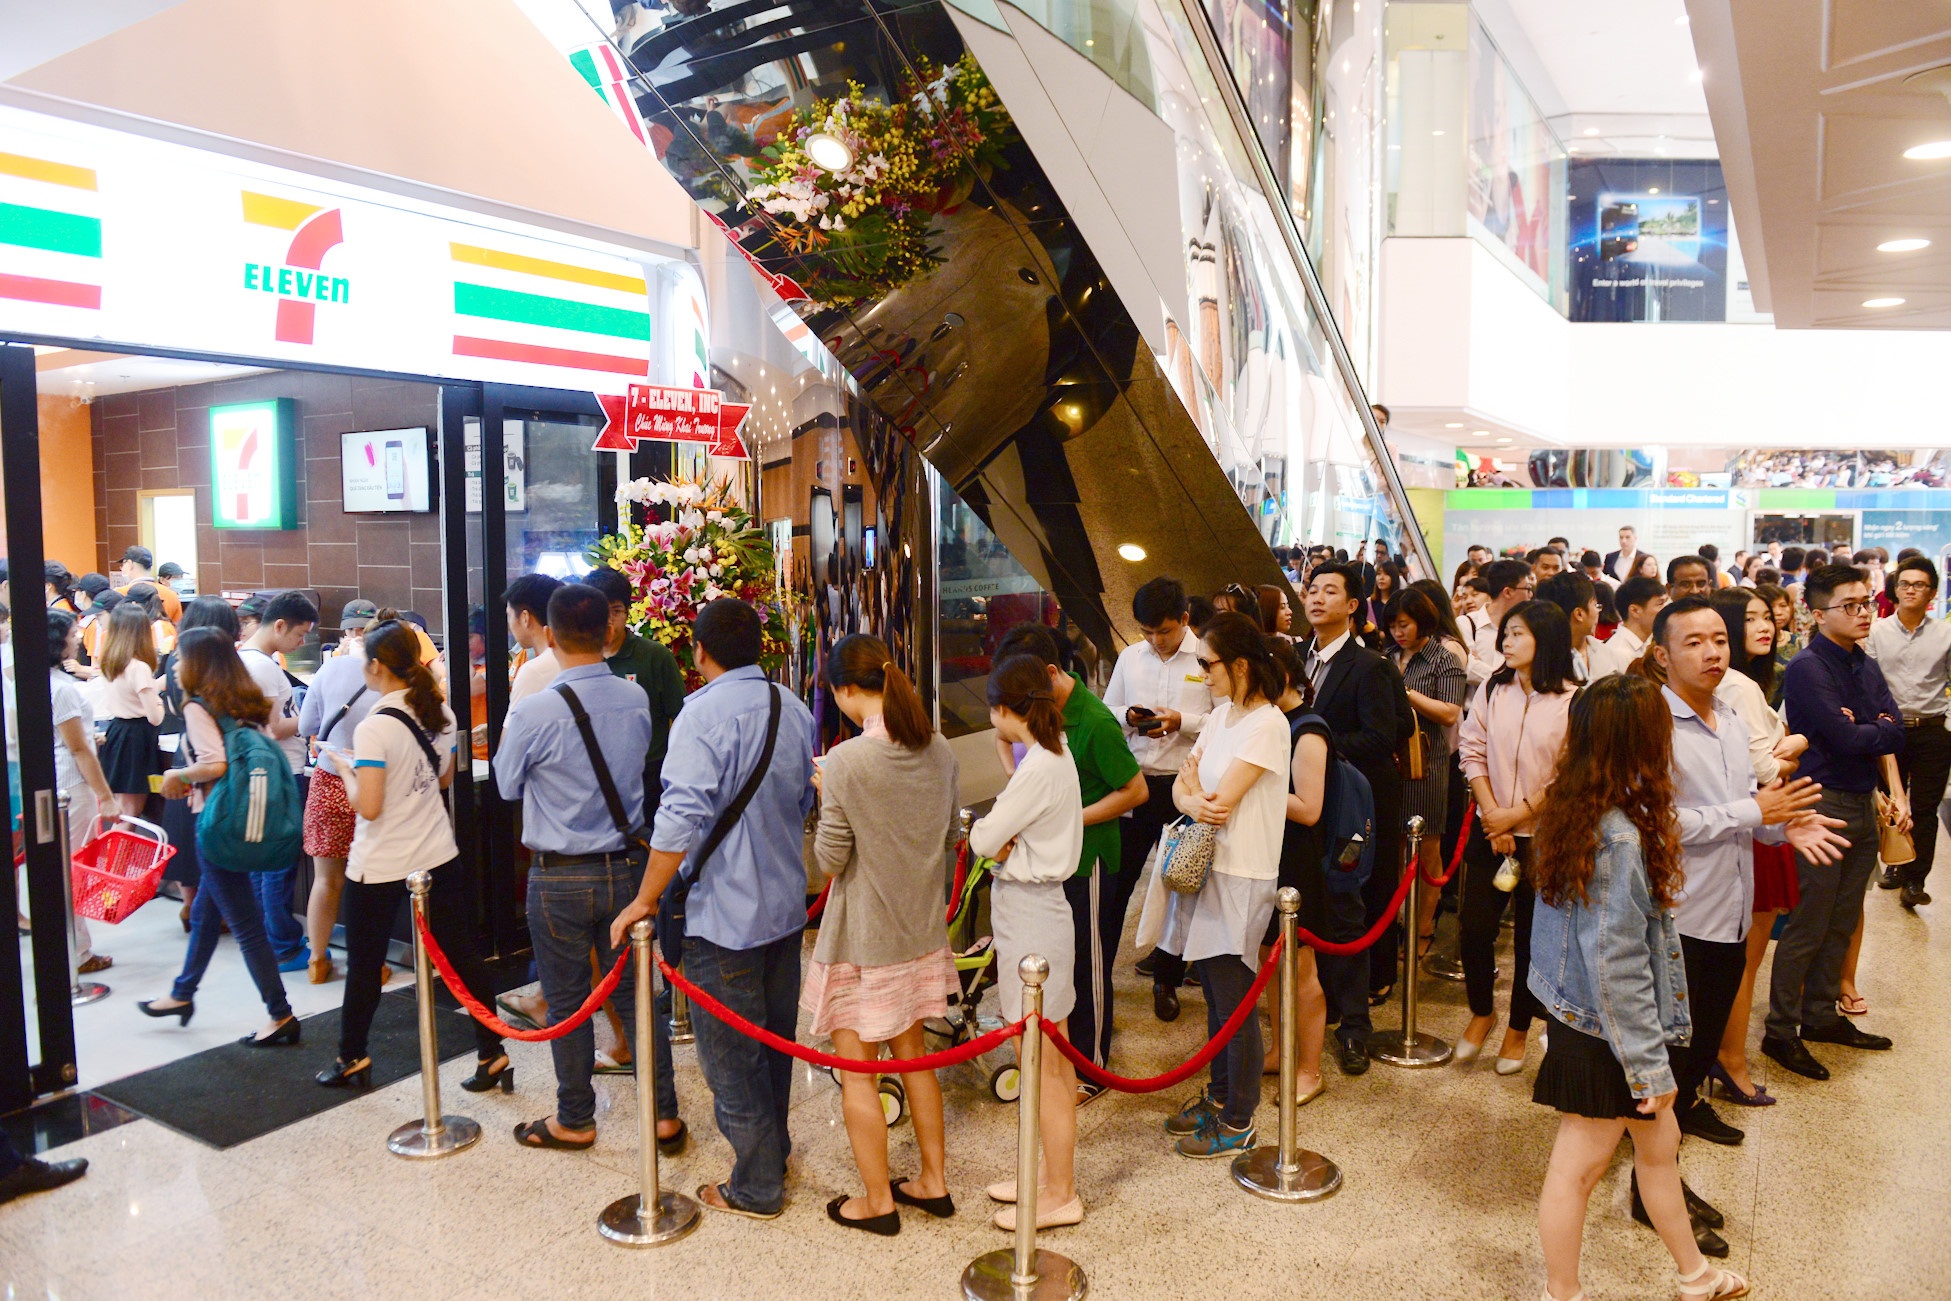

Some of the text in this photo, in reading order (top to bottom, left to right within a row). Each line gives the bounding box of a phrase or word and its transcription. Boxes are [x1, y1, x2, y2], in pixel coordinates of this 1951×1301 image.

[240, 190, 343, 345] 7
[1619, 278, 1639, 287] world
[1669, 278, 1704, 289] privileges
[631, 387, 639, 407] 7
[649, 388, 696, 415] ELEVEN,
[698, 392, 718, 415] INC
[1650, 494, 1725, 503] Standard Chartered
[1895, 521, 1903, 531] 2
